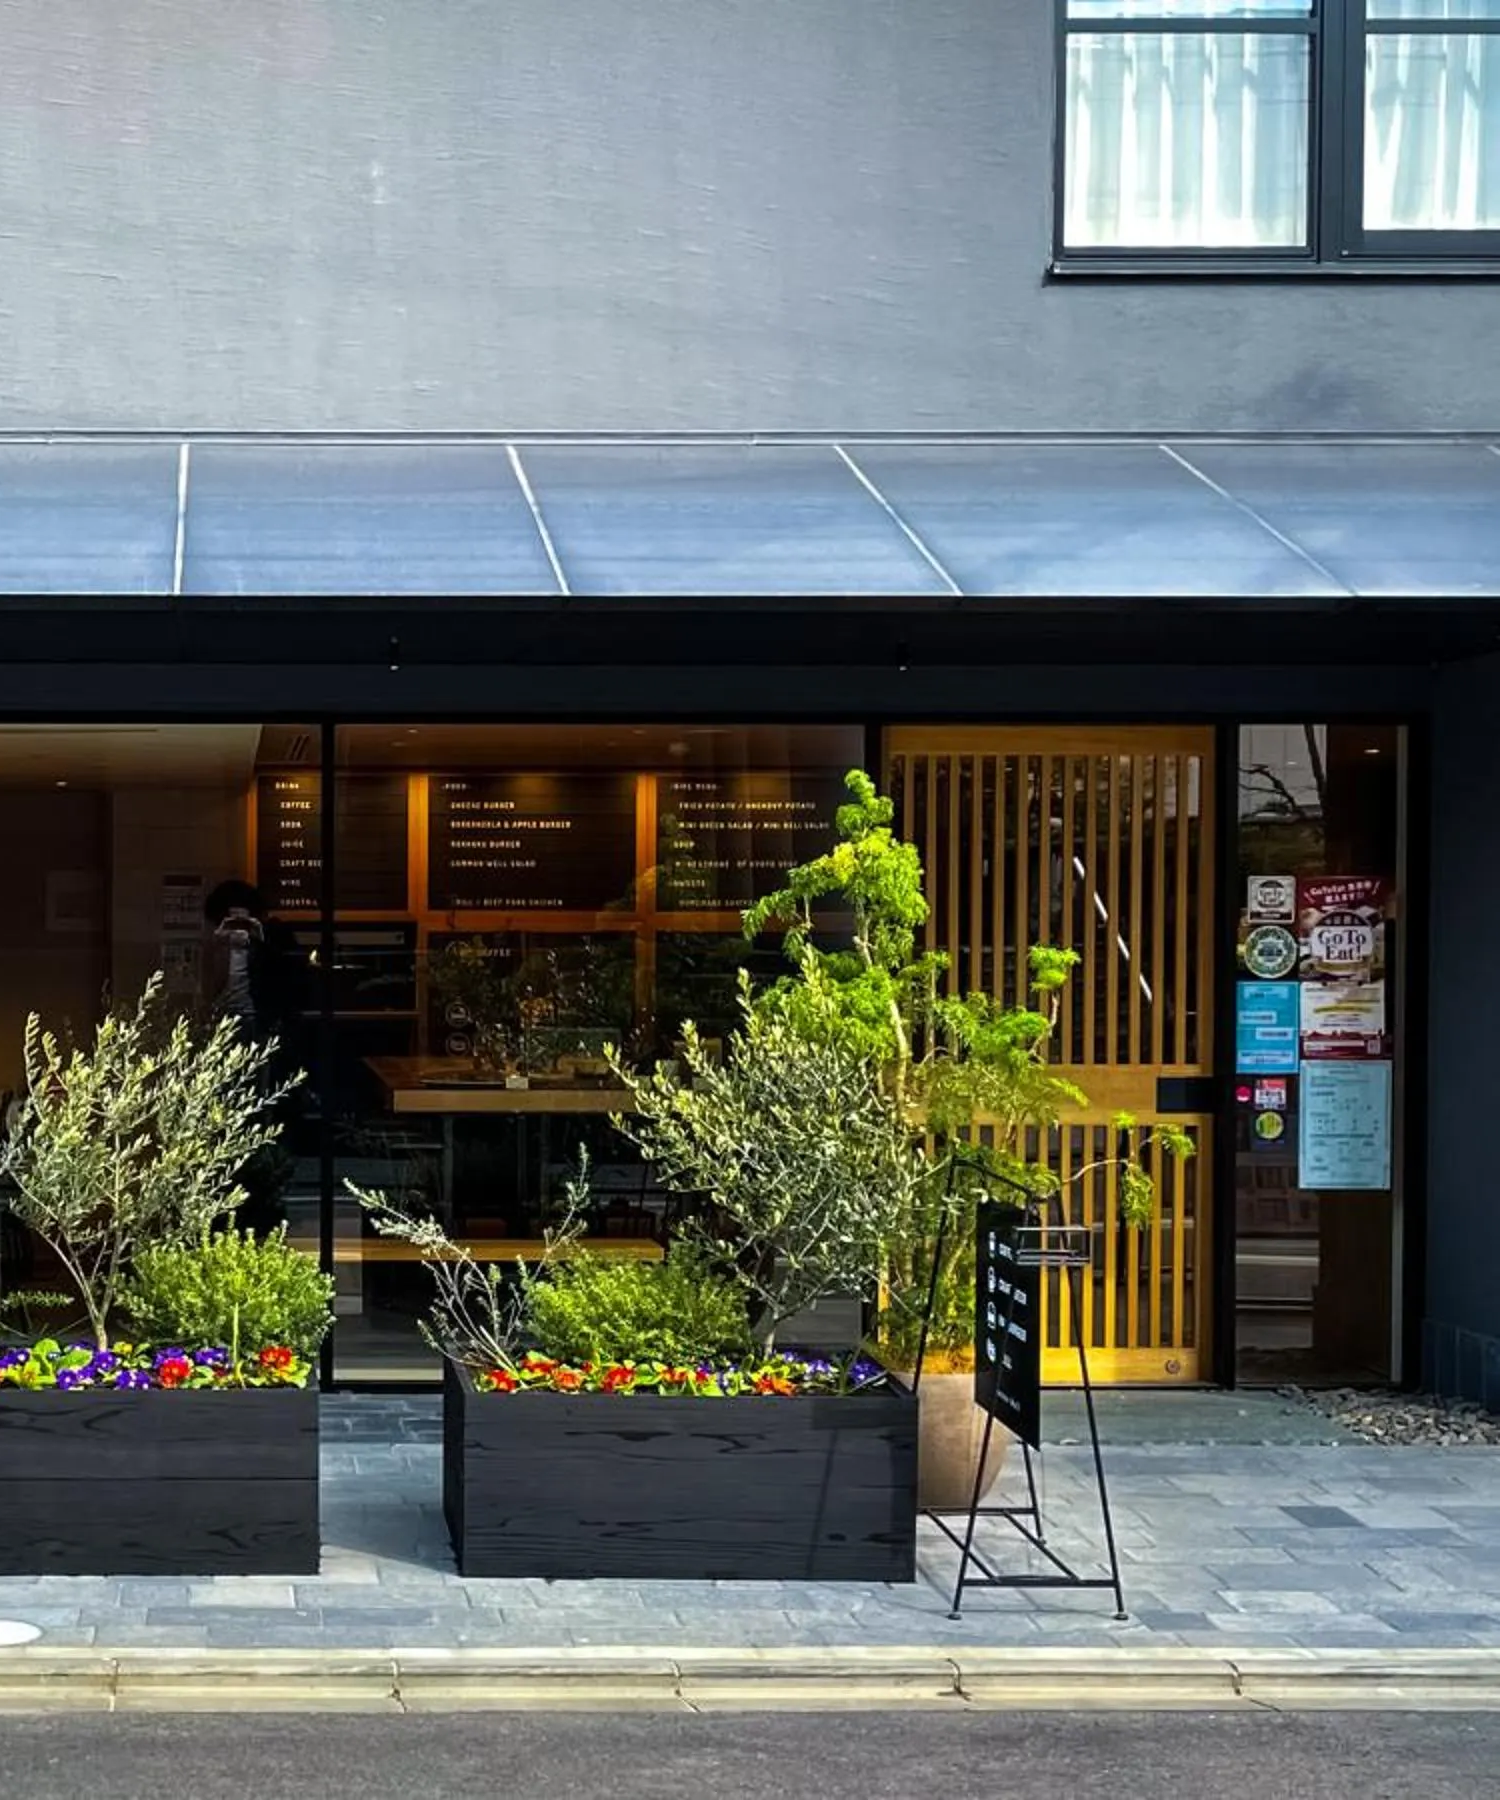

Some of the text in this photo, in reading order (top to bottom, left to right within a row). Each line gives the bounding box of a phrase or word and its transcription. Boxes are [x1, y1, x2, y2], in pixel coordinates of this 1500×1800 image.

[511, 820, 537, 829] APPLE
[307, 859, 322, 868] BEE
[1326, 945, 1362, 961] Eat!
